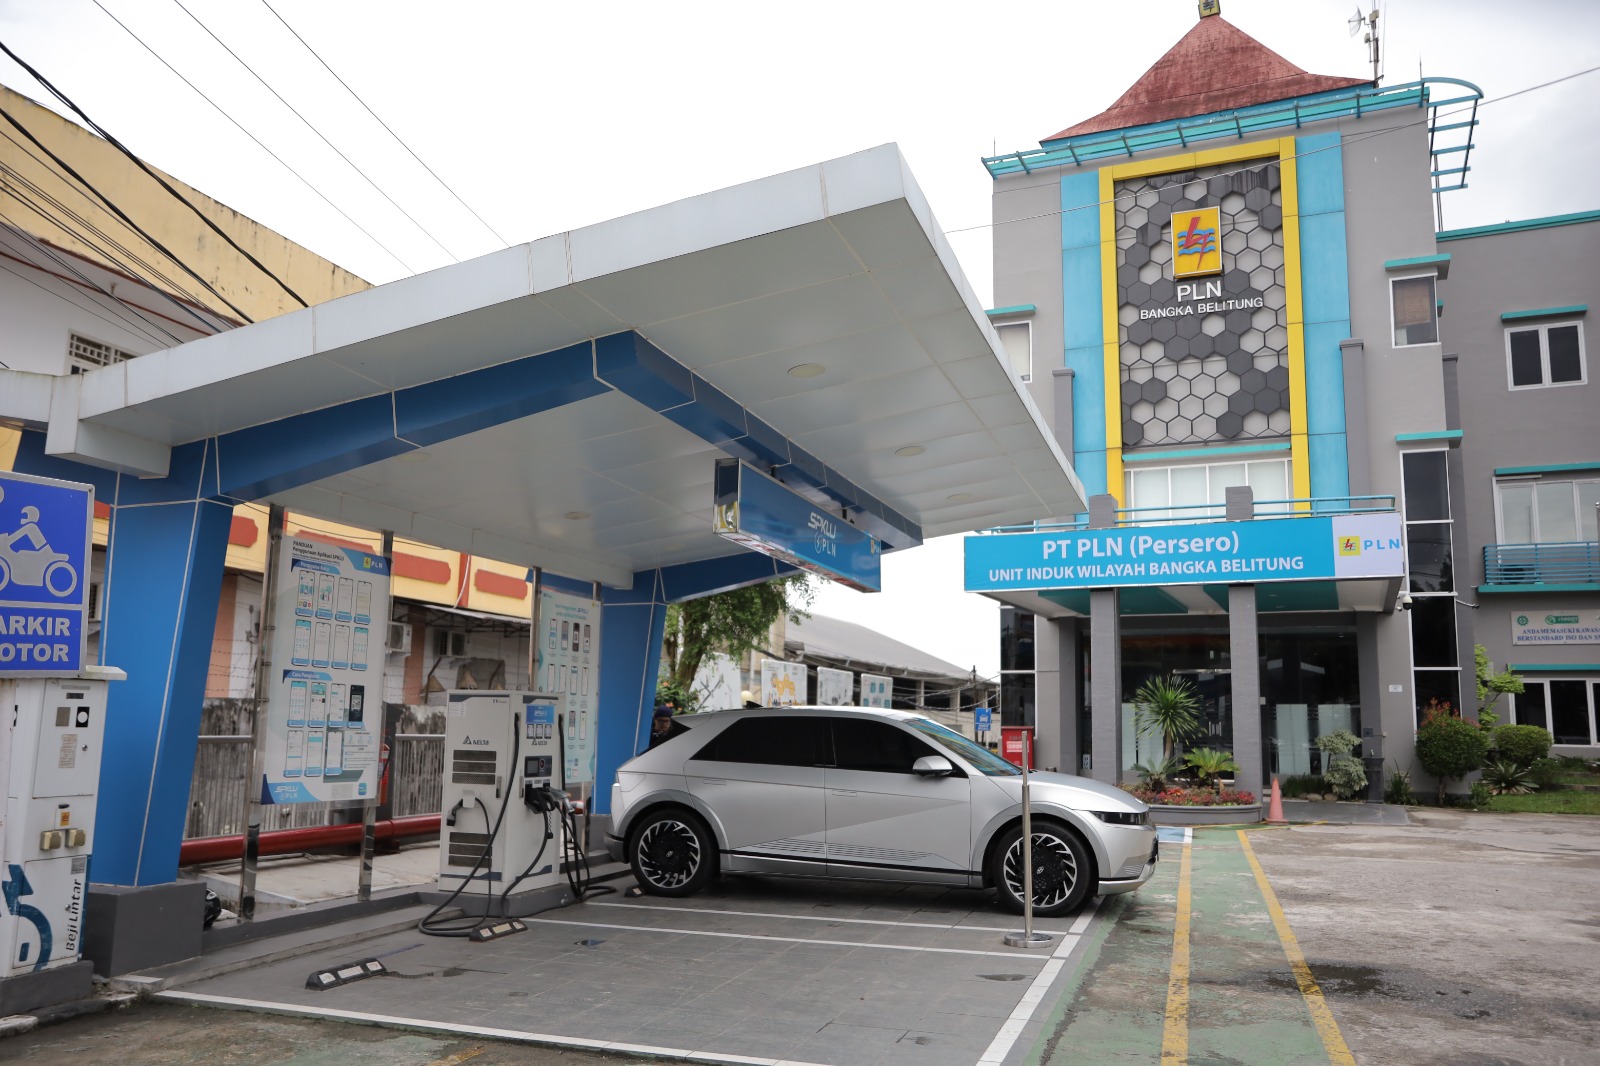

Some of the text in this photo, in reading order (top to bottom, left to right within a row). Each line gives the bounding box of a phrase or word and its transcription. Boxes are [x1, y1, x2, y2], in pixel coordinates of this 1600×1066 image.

[1177, 280, 1222, 302] PLN
[1140, 297, 1264, 320] BANGKA BELITUNG
[822, 538, 836, 557] PLN
[1043, 530, 1239, 560] PT PLN (Persero)
[1363, 538, 1400, 551] PLN
[371, 561, 383, 569] PLN
[989, 556, 1304, 582] UNIT INDUK WILAYAH BANGKA BELITUNG
[69, 878, 82, 922] Lintar
[66, 924, 78, 951] Beji
